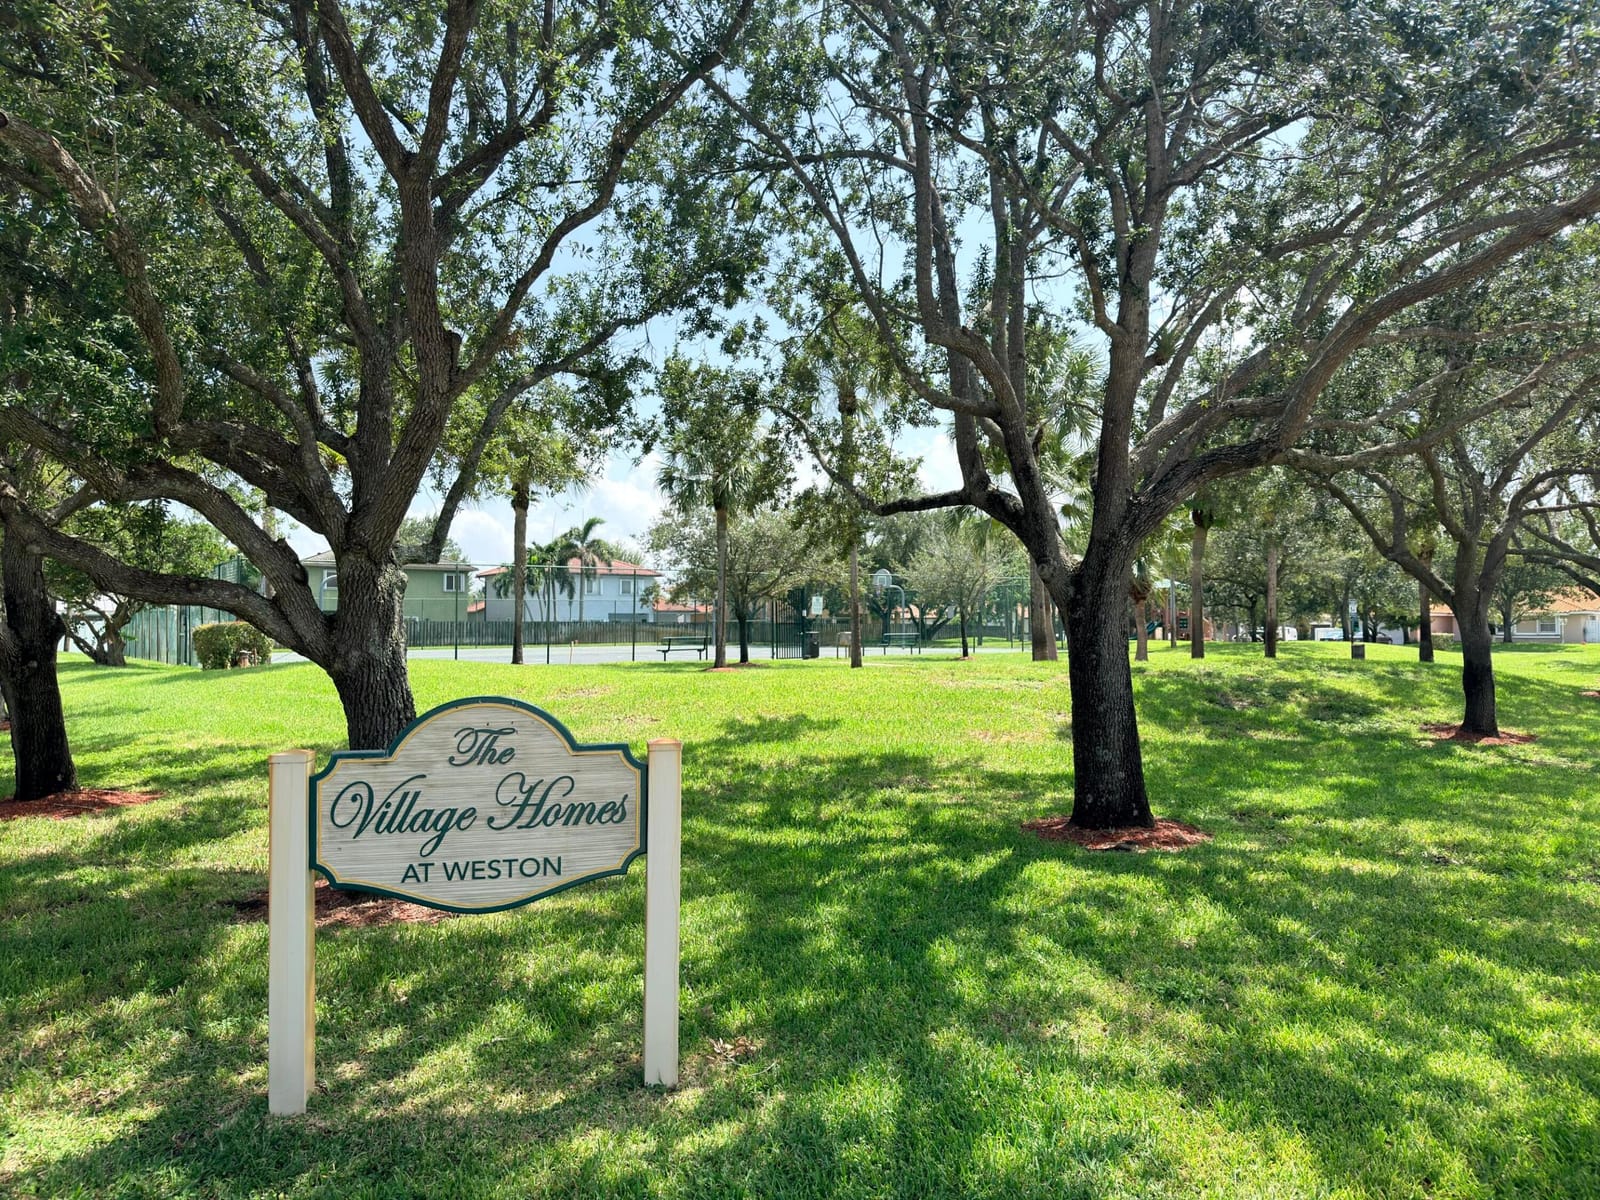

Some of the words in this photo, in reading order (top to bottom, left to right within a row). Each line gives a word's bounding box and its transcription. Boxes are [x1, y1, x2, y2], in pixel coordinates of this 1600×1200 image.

[448, 727, 517, 766] The
[330, 774, 477, 857] Village
[487, 771, 629, 830] Homes
[401, 863, 434, 883] AT
[443, 856, 562, 880] WESTON
